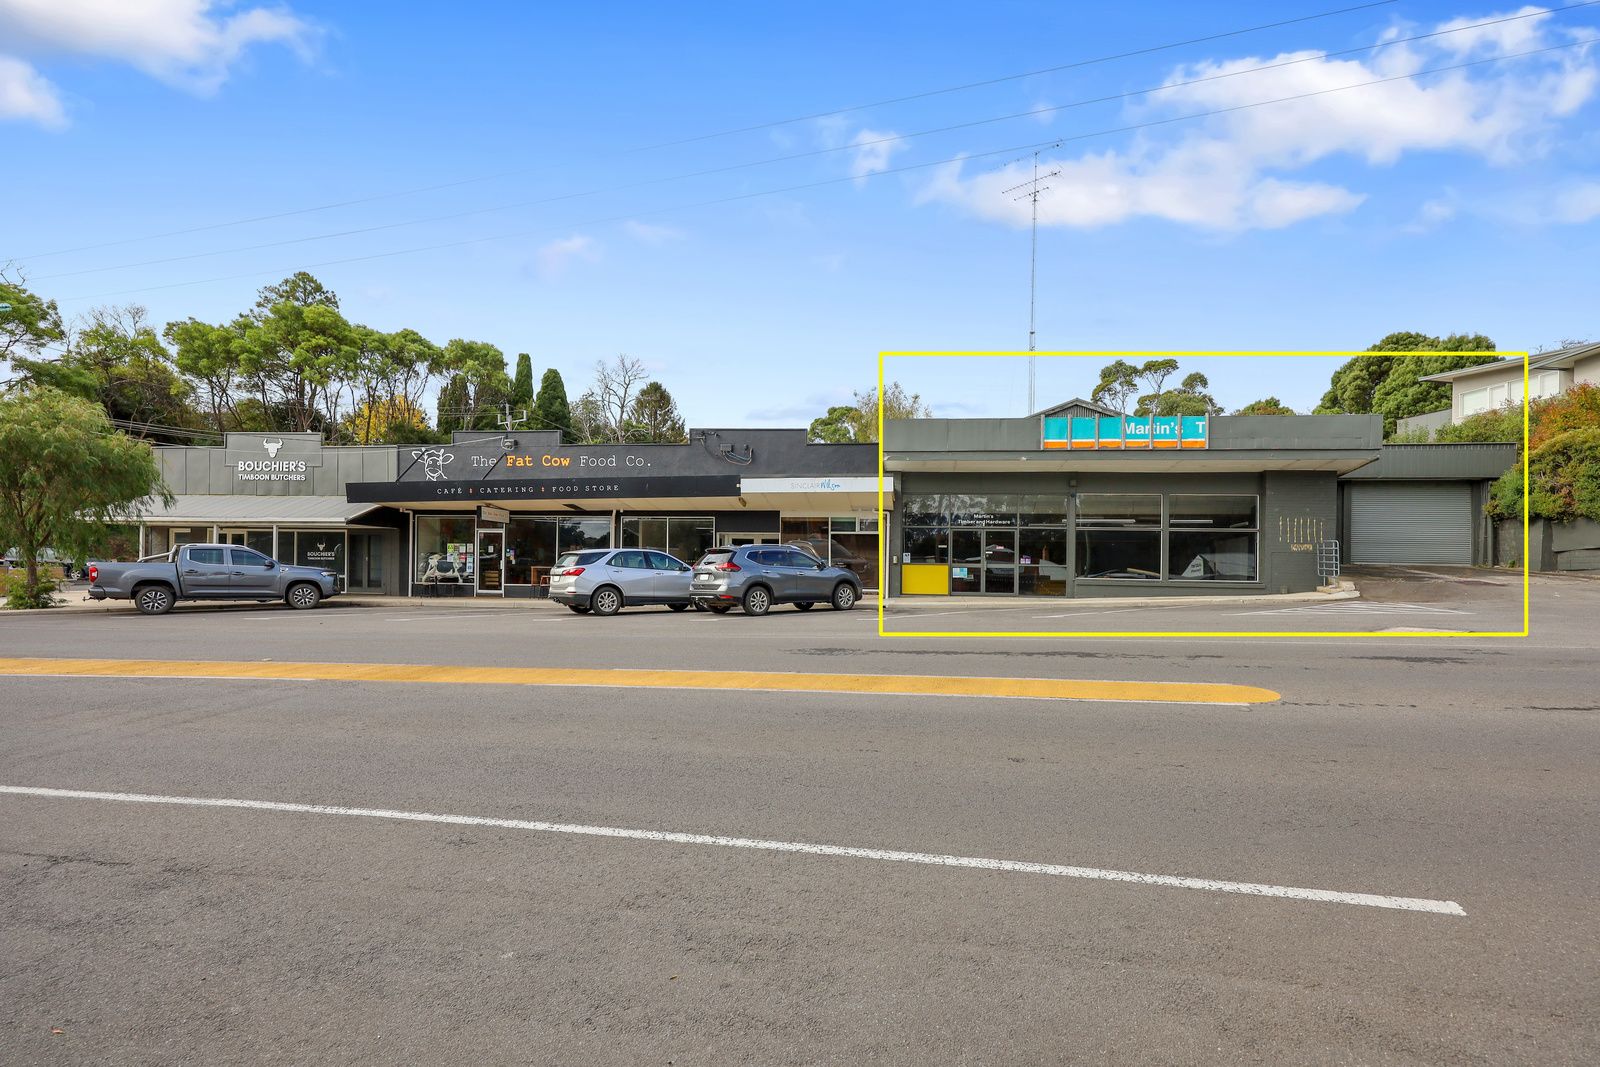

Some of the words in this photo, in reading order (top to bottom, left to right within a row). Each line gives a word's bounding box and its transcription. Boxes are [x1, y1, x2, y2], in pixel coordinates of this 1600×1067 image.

[1195, 421, 1206, 434] T
[238, 460, 307, 472] BOUCHIER'S
[471, 456, 497, 467] The
[506, 455, 533, 467] Fat
[542, 455, 571, 467] Cow
[579, 454, 617, 467] Food
[625, 455, 652, 467] Co.
[238, 473, 270, 481] TIMBOON
[479, 486, 535, 494] CATERING
[552, 485, 579, 493] FOOD
[585, 484, 619, 492] STORE
